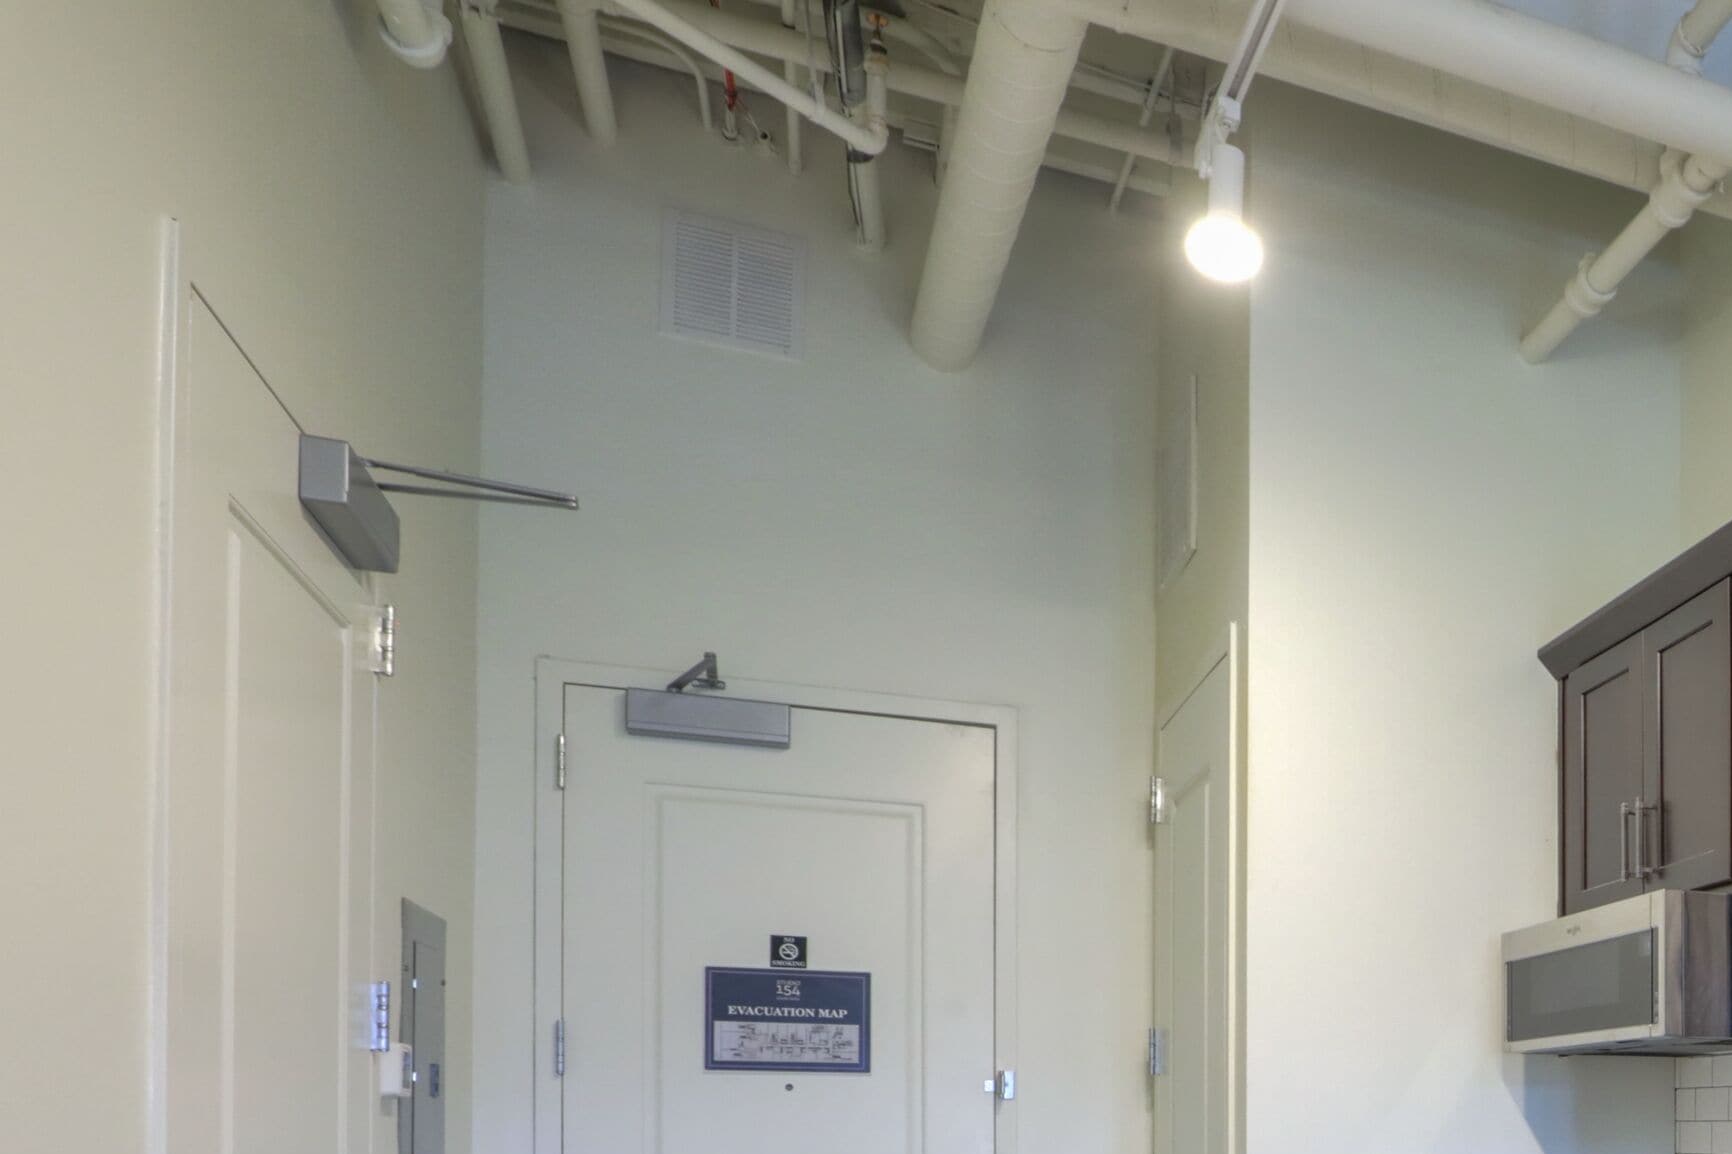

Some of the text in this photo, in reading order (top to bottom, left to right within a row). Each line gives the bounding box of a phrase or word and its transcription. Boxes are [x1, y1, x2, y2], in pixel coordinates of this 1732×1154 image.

[776, 985, 801, 996] 154
[727, 1005, 848, 1019] EVACUATION MAP
